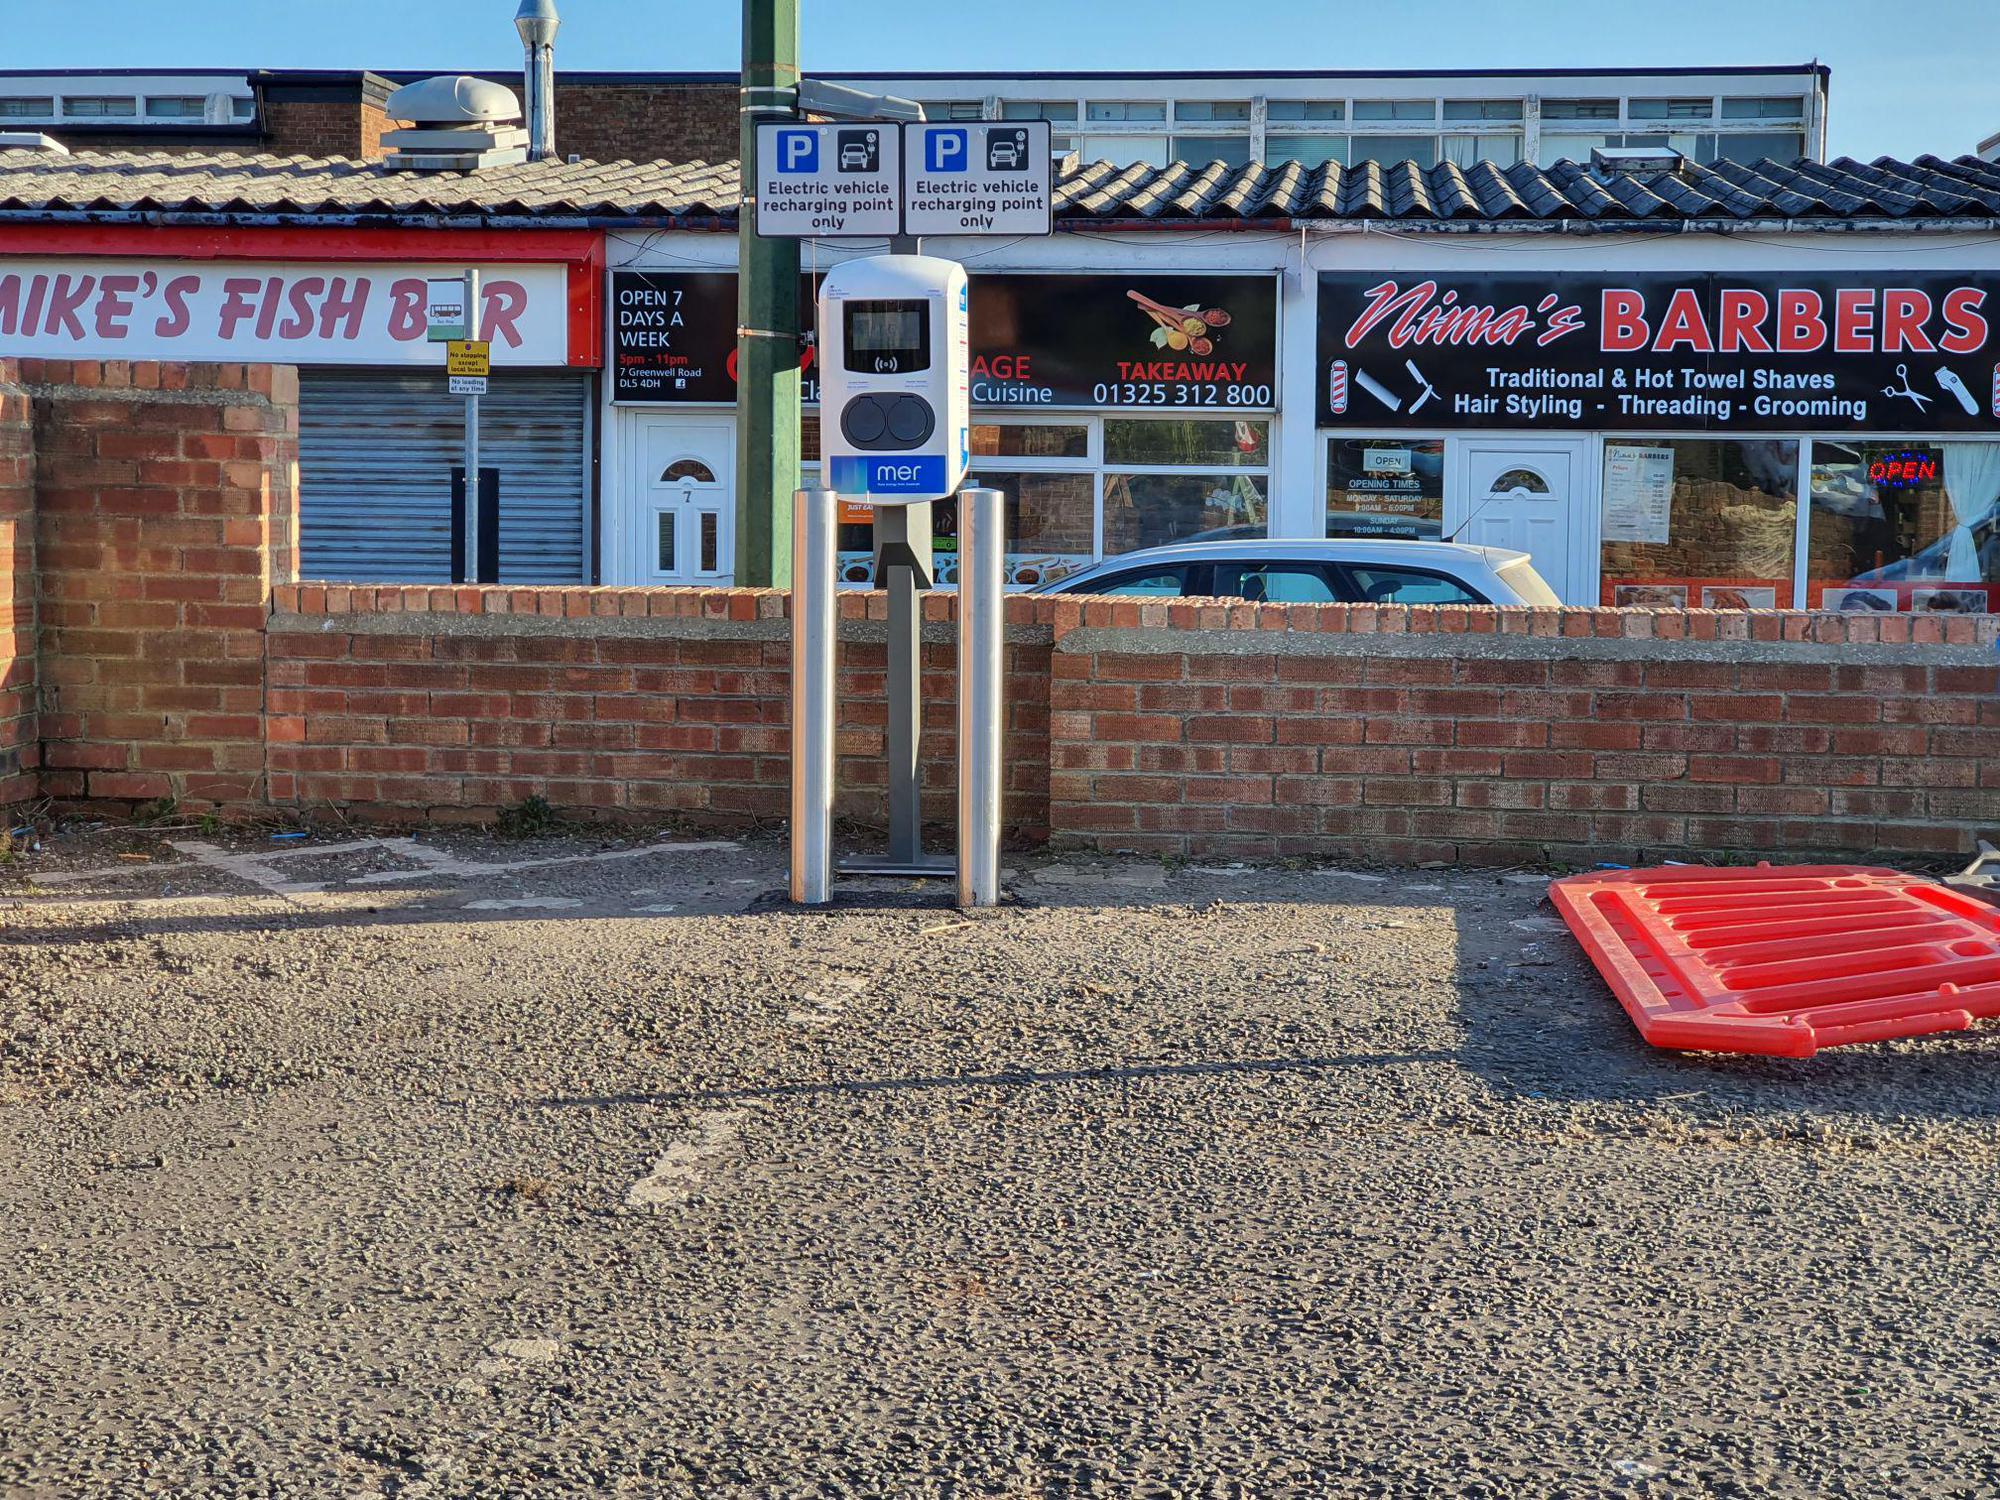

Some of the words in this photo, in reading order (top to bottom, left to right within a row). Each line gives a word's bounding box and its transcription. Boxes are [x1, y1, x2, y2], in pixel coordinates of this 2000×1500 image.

[787, 135, 812, 169] P
[935, 134, 961, 168] P
[768, 181, 829, 194] Electric
[834, 181, 889, 194] vehicle
[916, 180, 977, 194] Electric
[983, 180, 1039, 193] vehicle
[764, 200, 847, 213] recharging
[853, 200, 893, 213] point
[911, 198, 996, 213] recharging
[1002, 198, 1043, 212] point
[812, 215, 845, 230] only
[960, 215, 994, 230] only
[620, 290, 666, 306] OPEN
[672, 290, 683, 305] 7
[218, 277, 371, 340] FISH
[387, 278, 528, 349] BR
[620, 311, 665, 326] DAYS
[670, 311, 684, 326] A
[1345, 280, 1585, 349] Nima's
[1600, 287, 1989, 354] BARBERS
[620, 331, 670, 347] WEEK
[460, 352, 487, 360] stopping
[619, 354, 645, 367] 5pm
[656, 353, 688, 367] 11pm
[620, 368, 626, 376] 7
[628, 367, 675, 377] Greenwell
[678, 367, 702, 377] Road
[1117, 362, 1247, 381] TAKEAWAY
[1486, 368, 1604, 388] Traditional
[1611, 369, 1628, 388] &
[1635, 369, 1674, 388] Hot
[1681, 369, 1745, 389] Towel
[1753, 369, 1836, 389] Shaves
[462, 378, 484, 386] loading
[620, 379, 637, 388] DL5
[640, 379, 660, 388] 4DH
[972, 381, 1053, 402] Cuisine
[1093, 383, 1166, 403] 01325
[1174, 384, 1217, 404] 312
[1226, 384, 1271, 405] 800
[1454, 394, 1499, 413] Hair
[1505, 394, 1582, 419] Styling
[1618, 394, 1731, 420] Threading
[1754, 395, 1867, 421] Grooming
[1375, 456, 1401, 465] OPEN
[877, 465, 922, 481] mer
[1869, 461, 1936, 480] OPEN
[1348, 479, 1390, 489] OPENING
[1392, 479, 1421, 489] TIMES
[683, 490, 692, 503] 7
[1346, 494, 1377, 502] MONDAY
[1384, 494, 1423, 502] SATURDAY
[1370, 517, 1399, 525] SUNDAY
